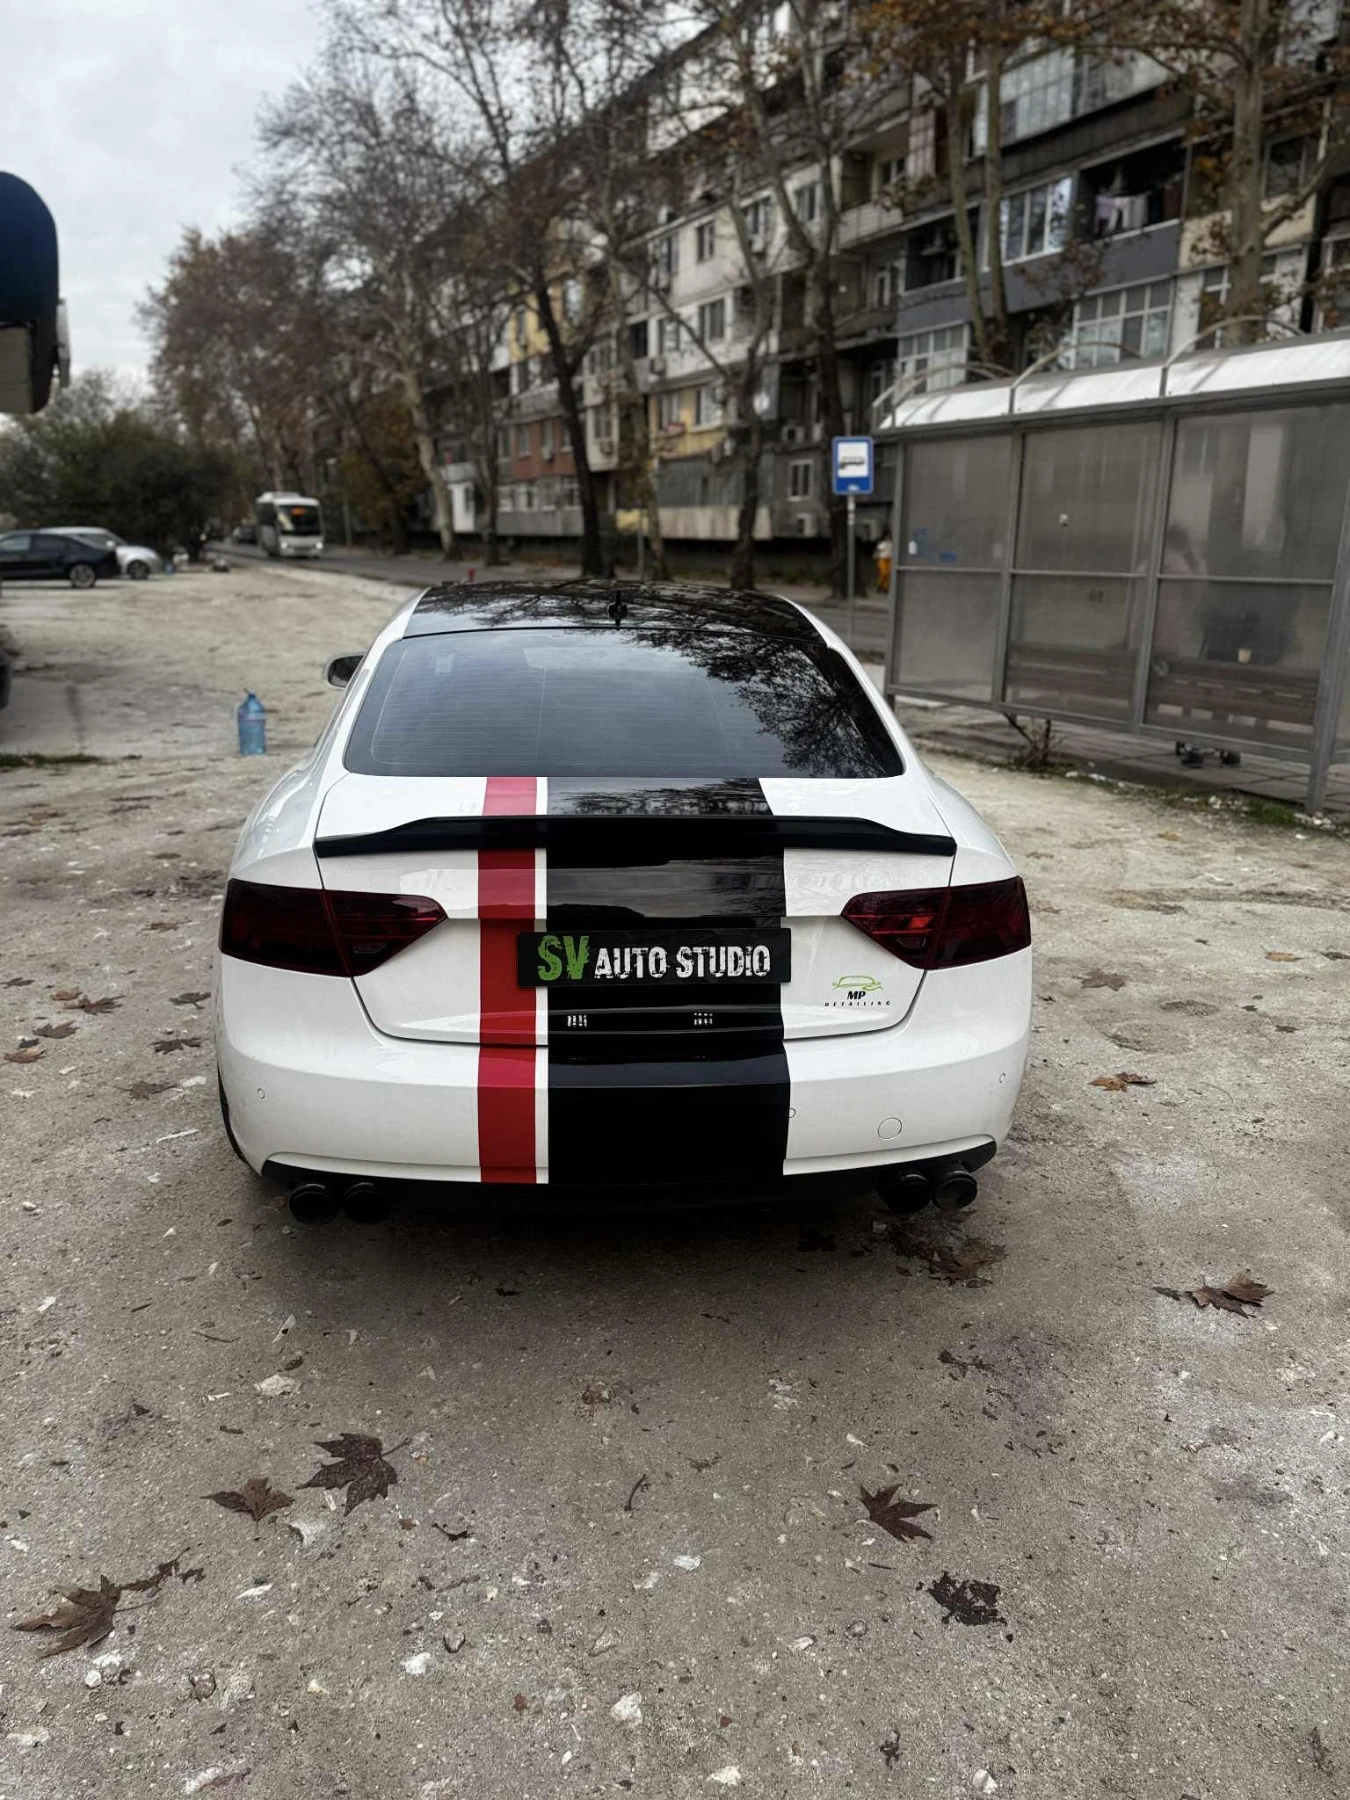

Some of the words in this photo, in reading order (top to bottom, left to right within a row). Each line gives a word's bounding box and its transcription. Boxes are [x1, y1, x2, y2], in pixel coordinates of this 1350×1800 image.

[537, 935, 590, 980] SV
[594, 946, 669, 979] AUTO
[676, 945, 771, 979] STUDIO
[847, 990, 867, 1000] MP
